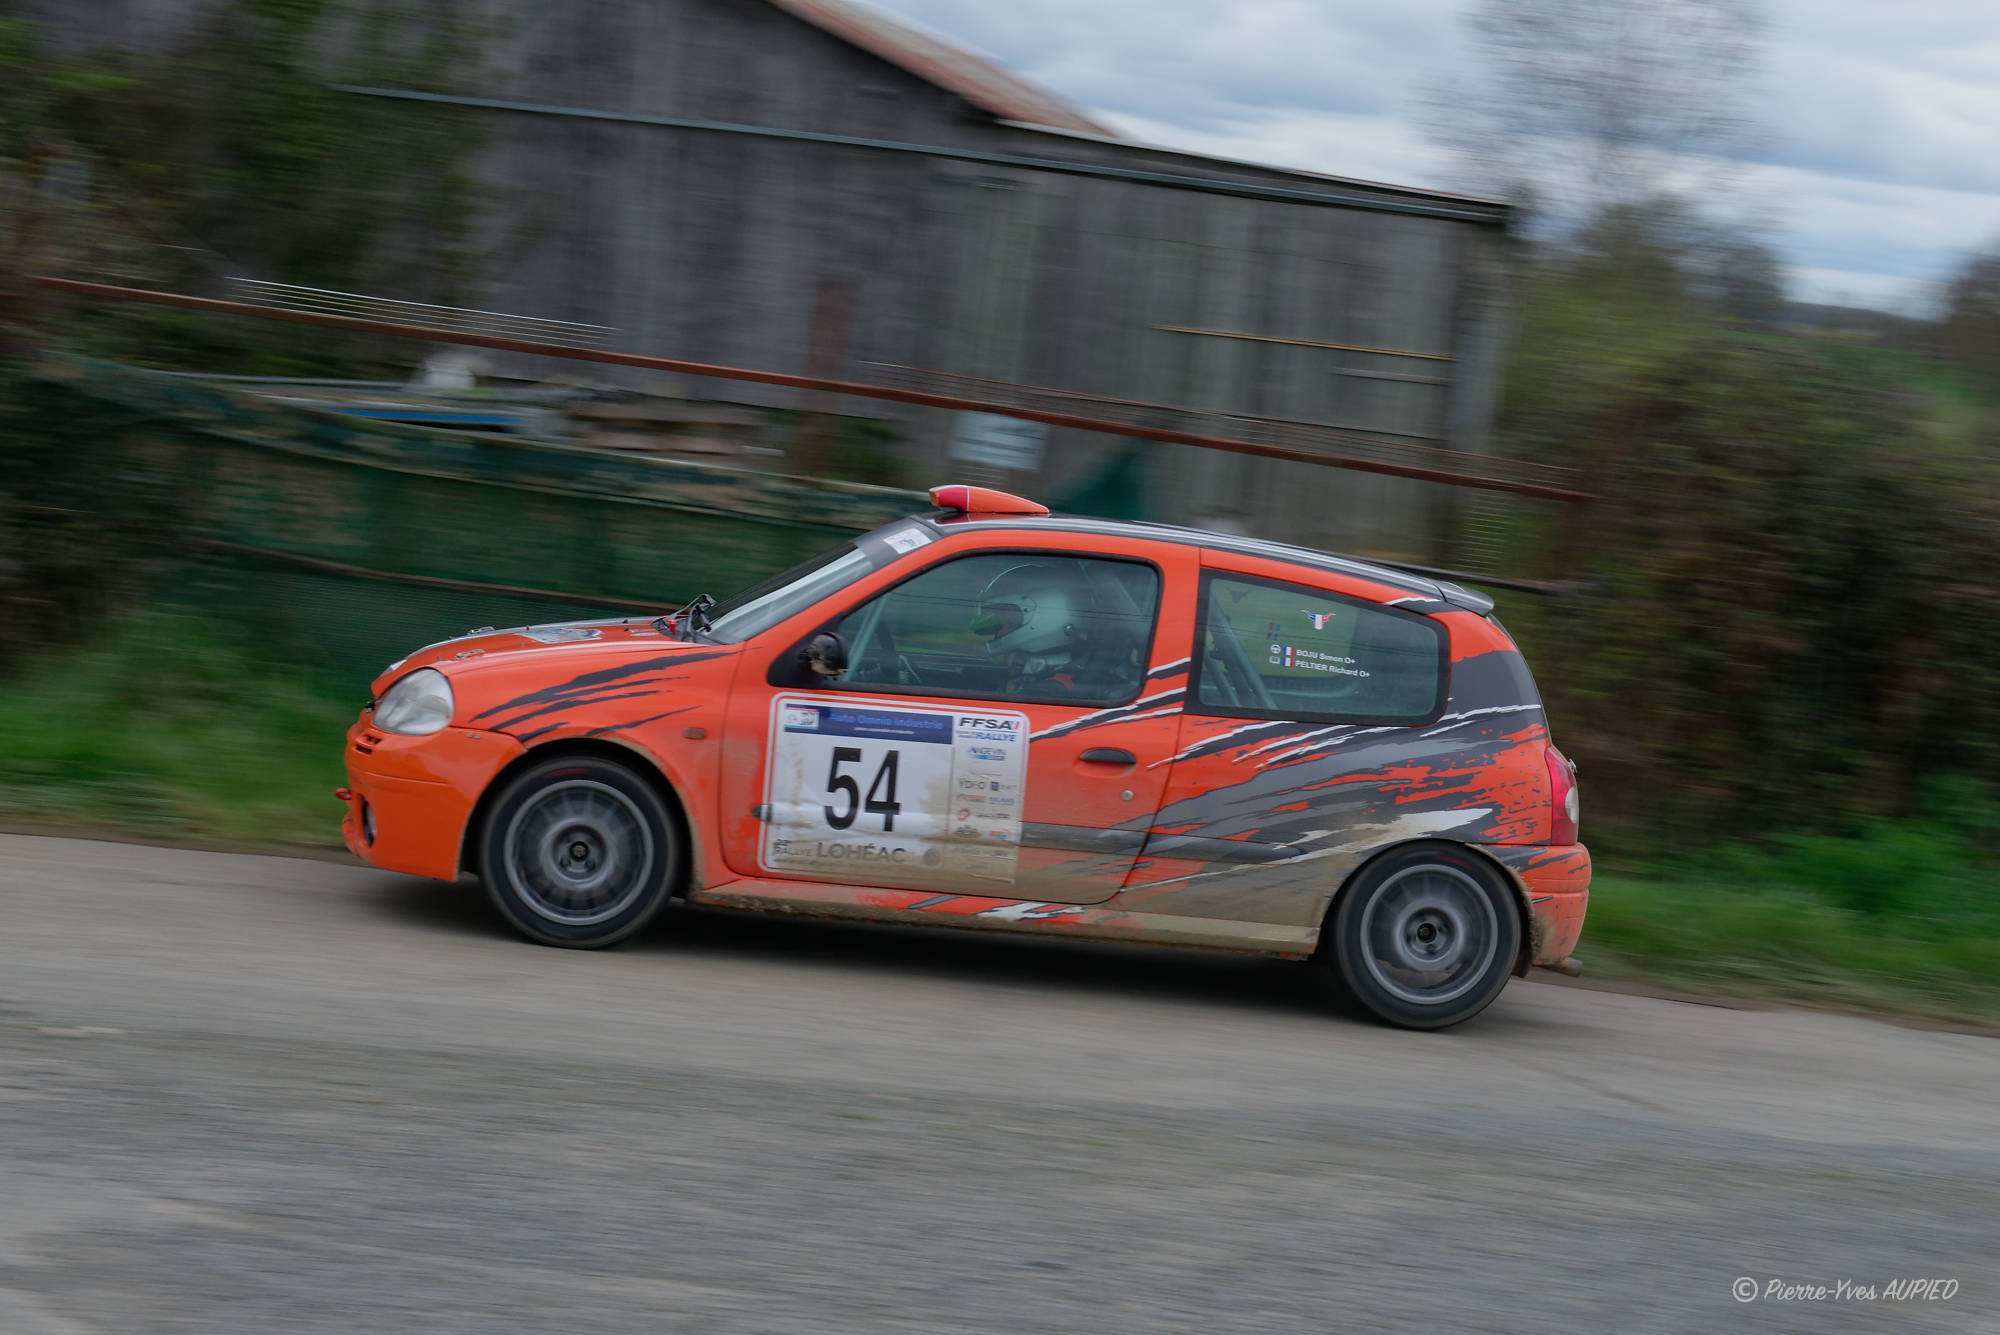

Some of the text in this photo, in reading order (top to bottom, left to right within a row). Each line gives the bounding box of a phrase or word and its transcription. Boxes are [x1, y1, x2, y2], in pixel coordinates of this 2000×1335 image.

[1296, 649, 1318, 659] BOJU
[1319, 653, 1343, 663] Simon
[1295, 660, 1327, 671] PELTIER
[1329, 665, 1358, 677] Richard
[894, 717, 944, 730] Industrie
[959, 717, 1012, 730] FFSA
[976, 732, 1017, 742] RALLYE
[824, 746, 901, 833] 54
[816, 841, 906, 863] LOHÉAC
